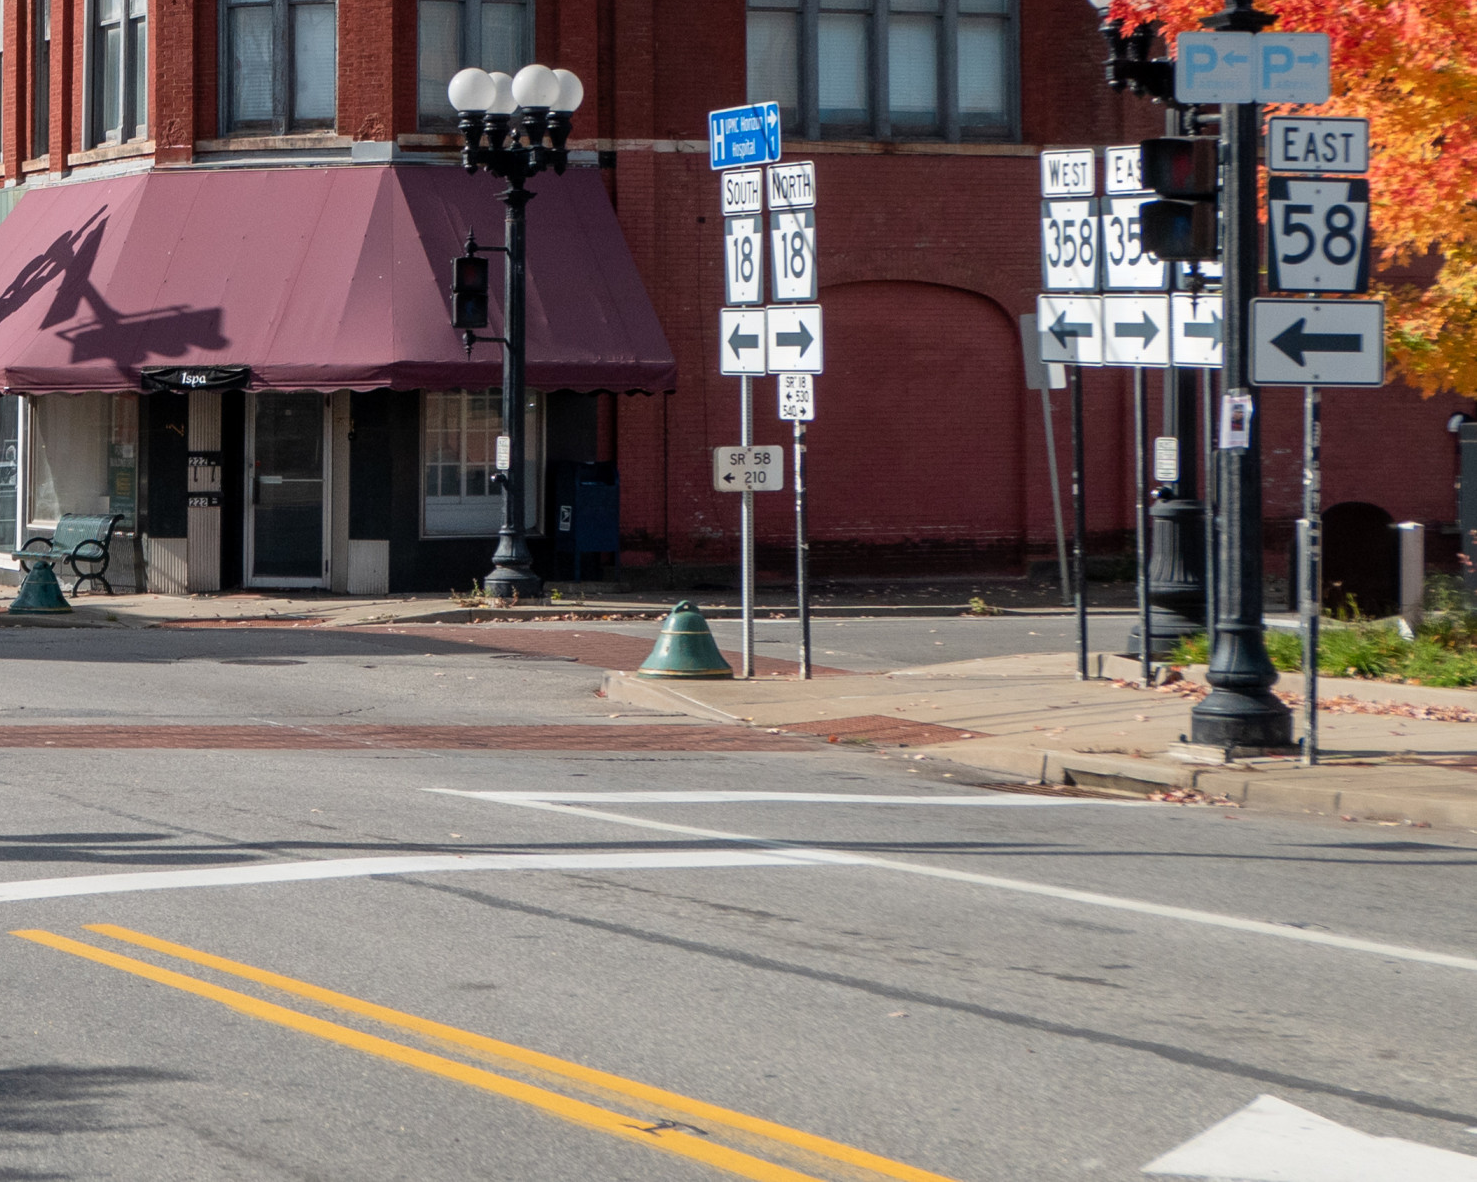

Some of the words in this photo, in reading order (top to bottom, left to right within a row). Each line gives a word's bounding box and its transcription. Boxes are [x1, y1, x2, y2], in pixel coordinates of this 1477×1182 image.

[713, 119, 725, 161] H
[741, 114, 763, 131] Horizon
[732, 138, 756, 160] Hospital
[1284, 127, 1355, 163] EAST
[1049, 159, 1088, 187] WEST
[1114, 156, 1142, 185] EAS
[726, 179, 759, 206] SOUTH
[772, 172, 811, 200] NORTH
[1048, 218, 1094, 268] 358
[1110, 216, 1160, 266] 35
[1282, 204, 1358, 266] 58
[733, 236, 754, 283] 18
[782, 231, 806, 279] 18
[785, 376, 795, 388] SR
[798, 376, 806, 388] 18
[795, 390, 810, 403] 530
[783, 405, 797, 417] 540
[730, 453, 746, 465] SR
[753, 452, 772, 465] 58
[744, 471, 767, 483] 210
